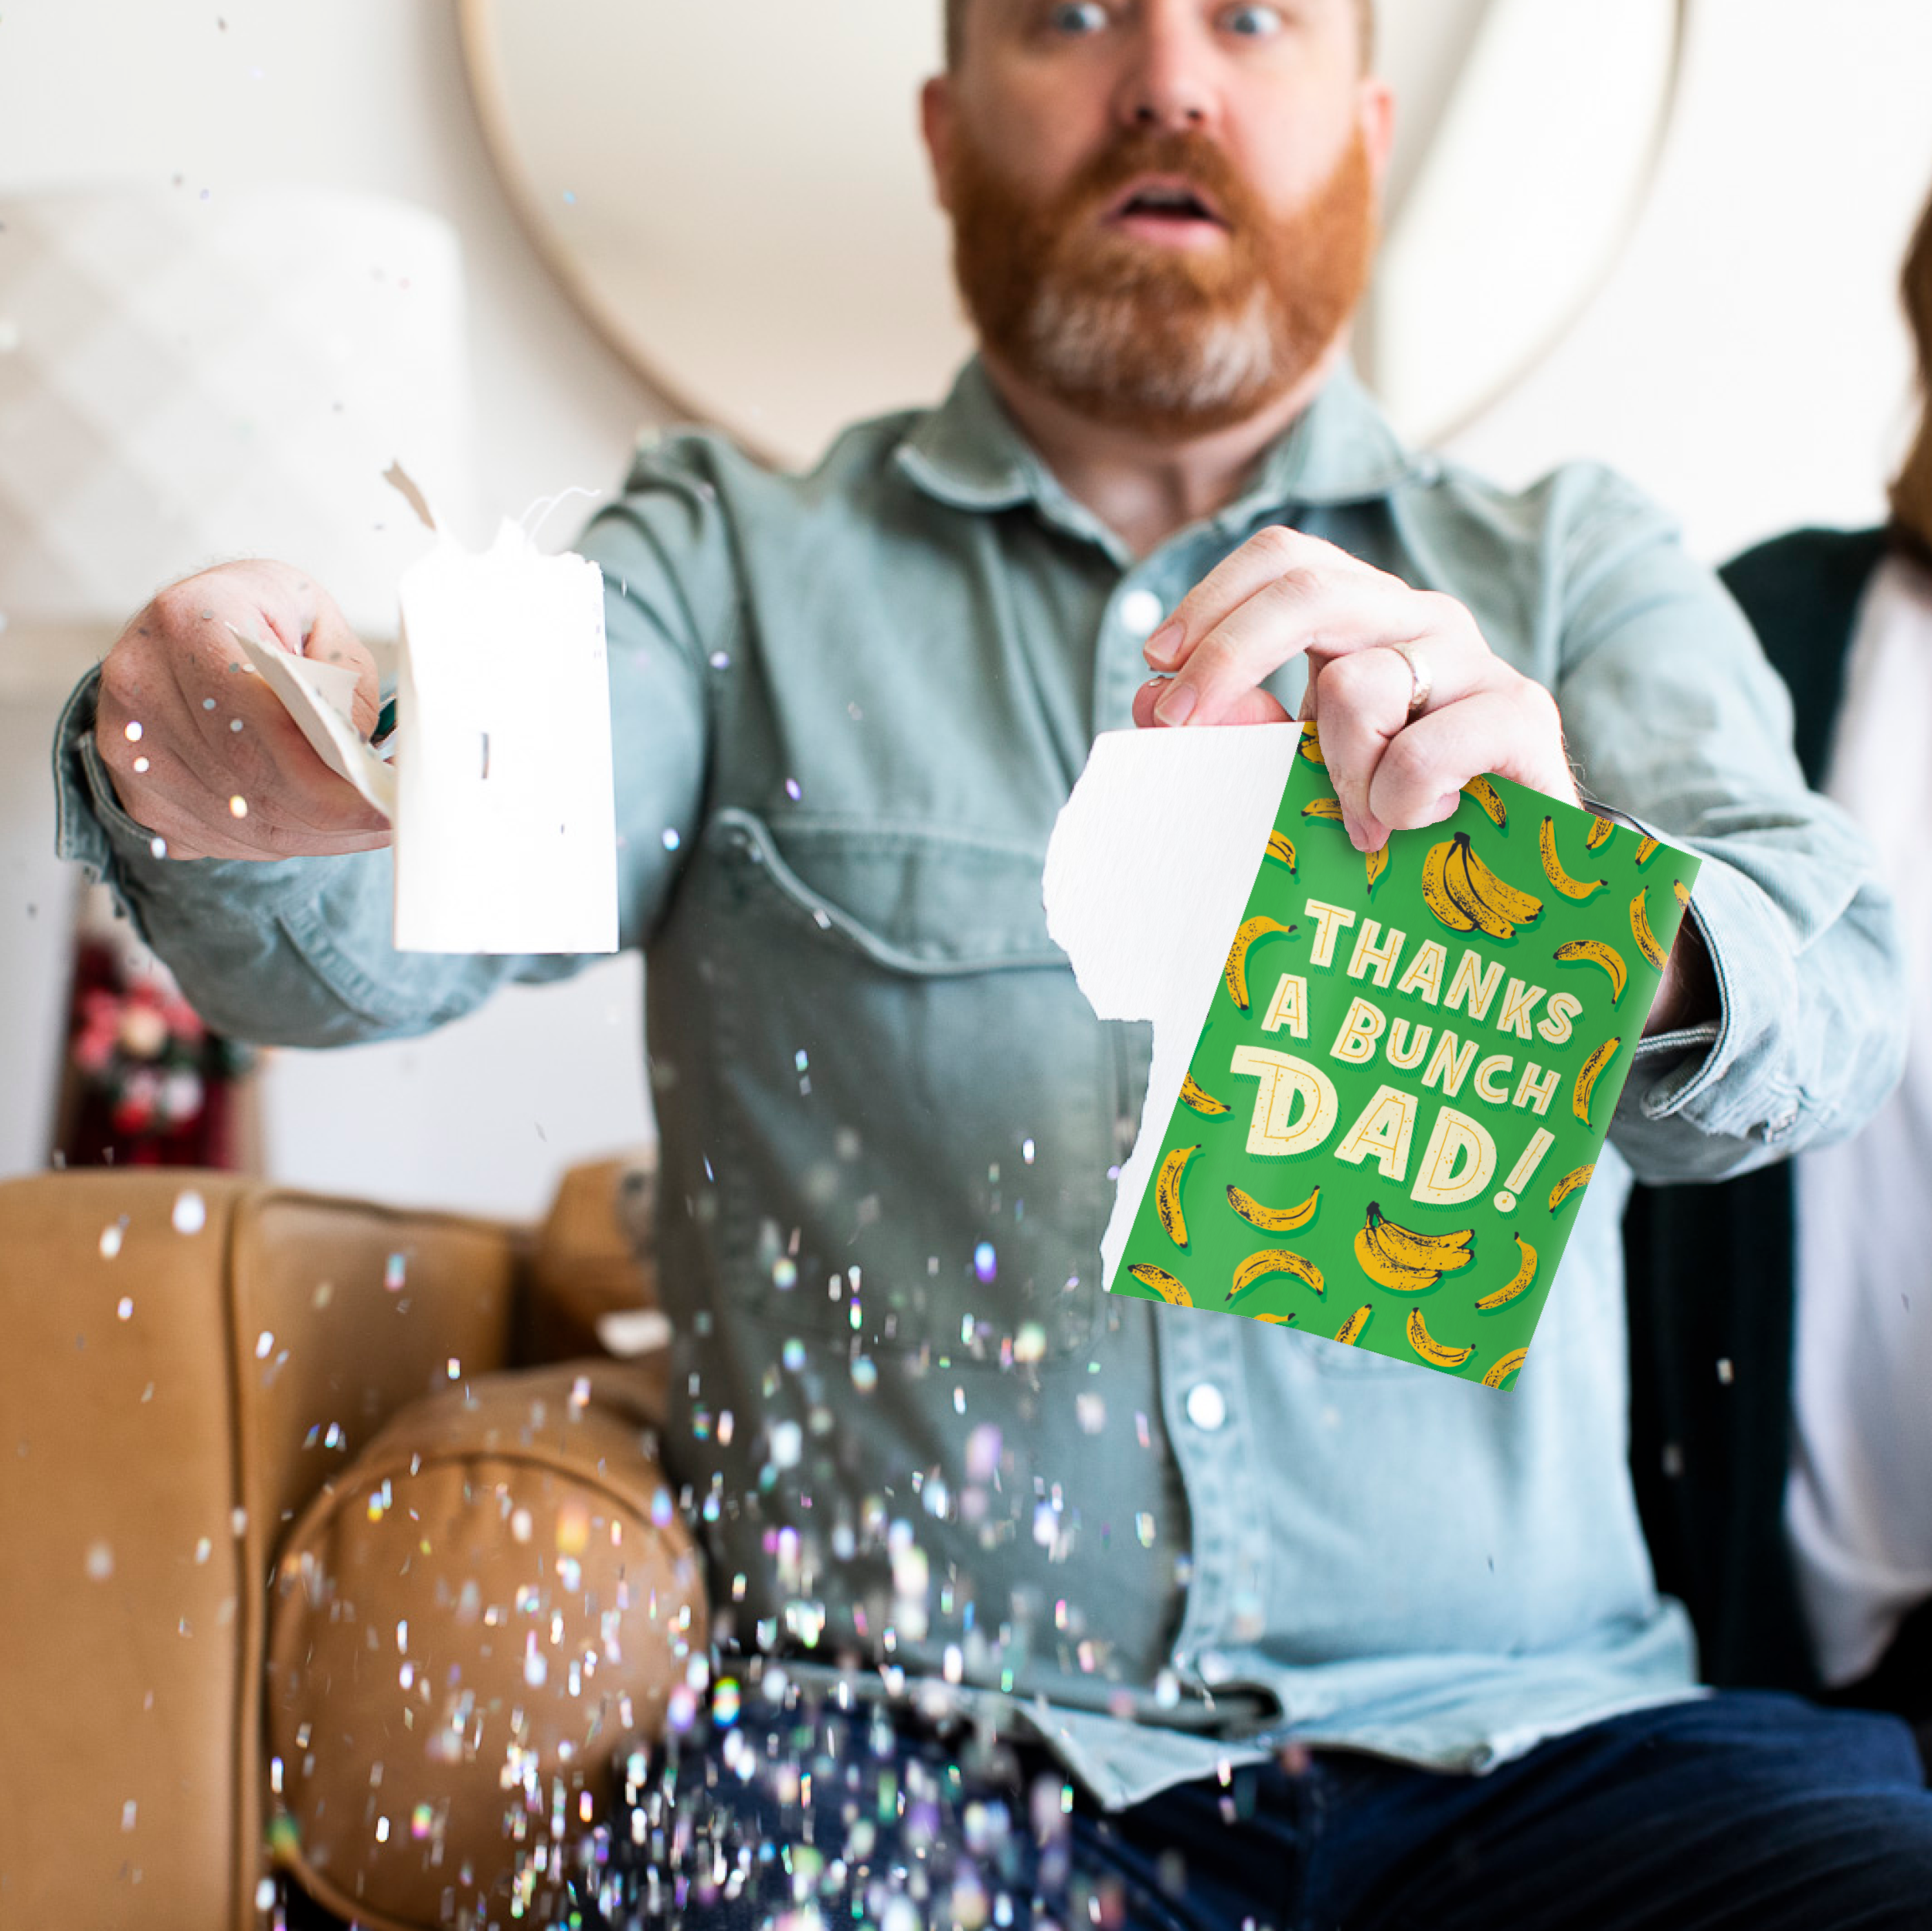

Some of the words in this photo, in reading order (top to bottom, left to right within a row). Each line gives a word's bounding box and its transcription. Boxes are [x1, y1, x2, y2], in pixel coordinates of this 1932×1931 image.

[1260, 973, 1308, 1039] A
[1329, 996, 1562, 1116] BUNCH
[1304, 898, 1583, 1045] THANKS
[1230, 1045, 1555, 1213] DAD!
